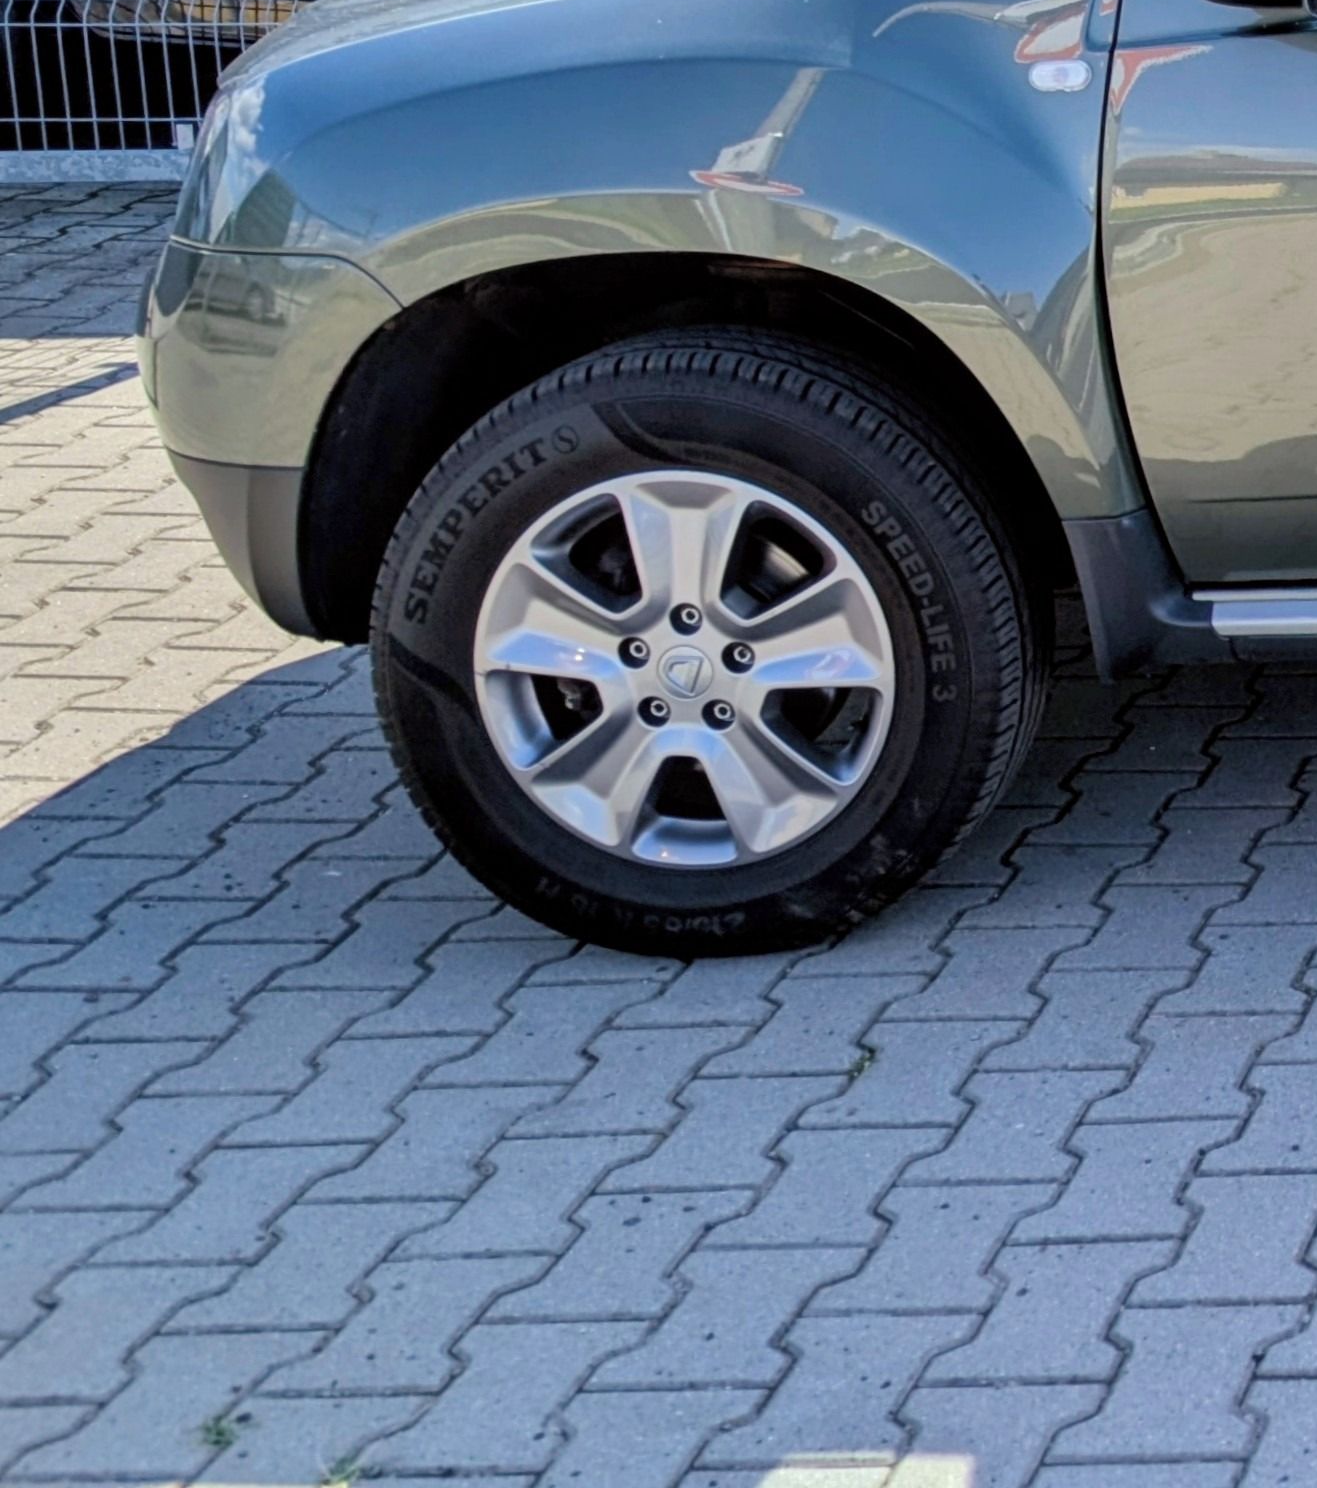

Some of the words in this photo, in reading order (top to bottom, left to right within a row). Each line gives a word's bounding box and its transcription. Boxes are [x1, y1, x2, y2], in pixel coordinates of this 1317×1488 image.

[403, 437, 547, 625] SEMPERIT
[861, 500, 957, 673] SPEED-LIFE
[932, 684, 958, 703] 3
